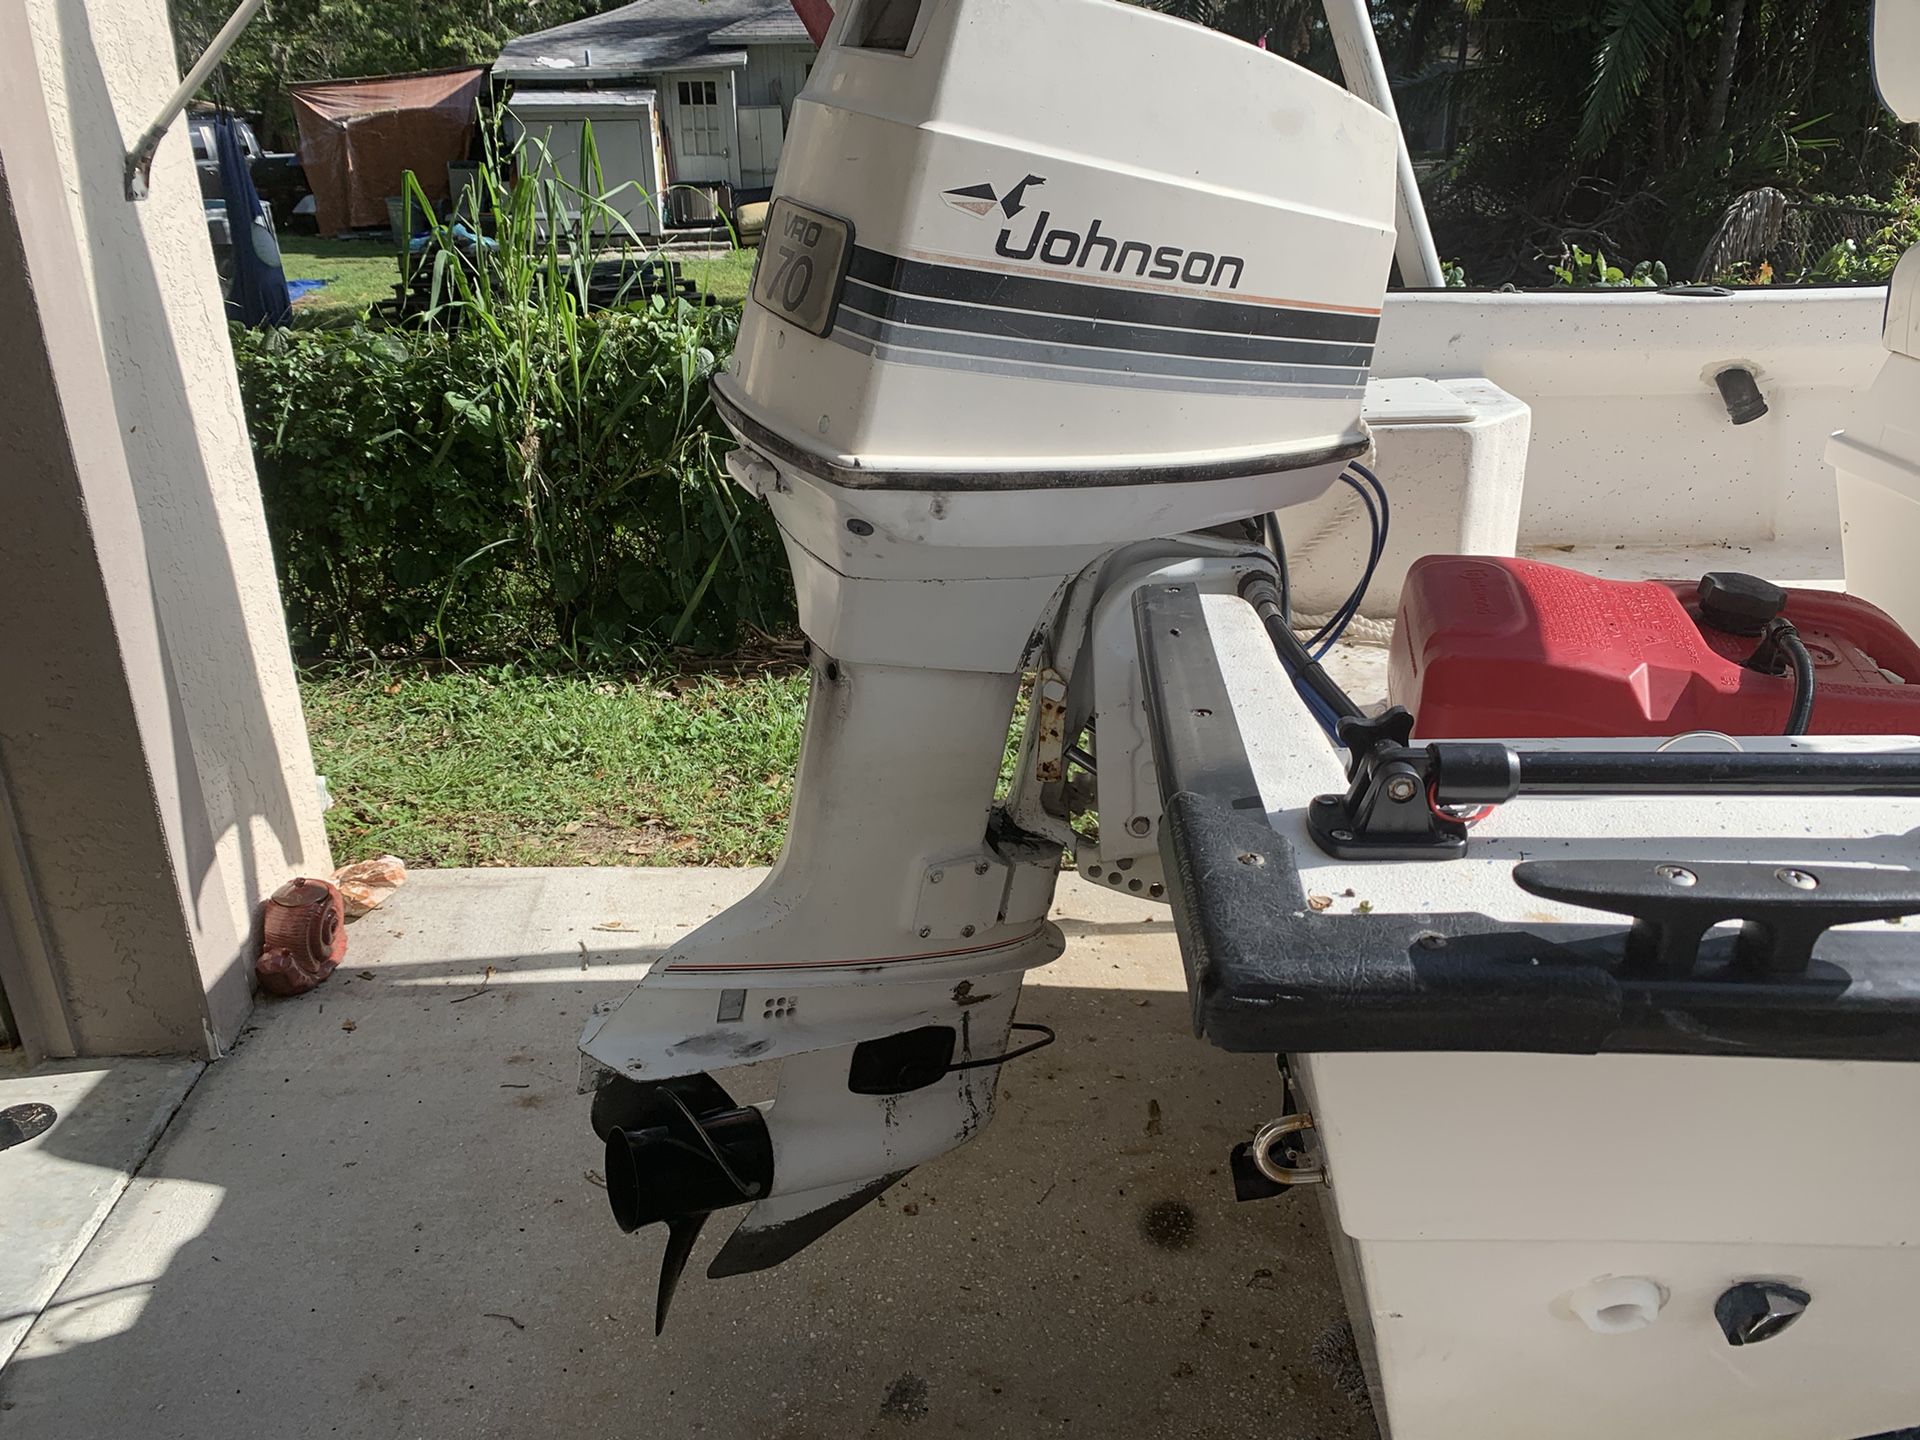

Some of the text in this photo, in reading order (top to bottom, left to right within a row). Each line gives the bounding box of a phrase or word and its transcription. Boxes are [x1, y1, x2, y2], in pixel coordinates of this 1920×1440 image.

[784, 211, 822, 248] VRO
[995, 210, 1245, 289] Johnson
[766, 245, 814, 312] 70
